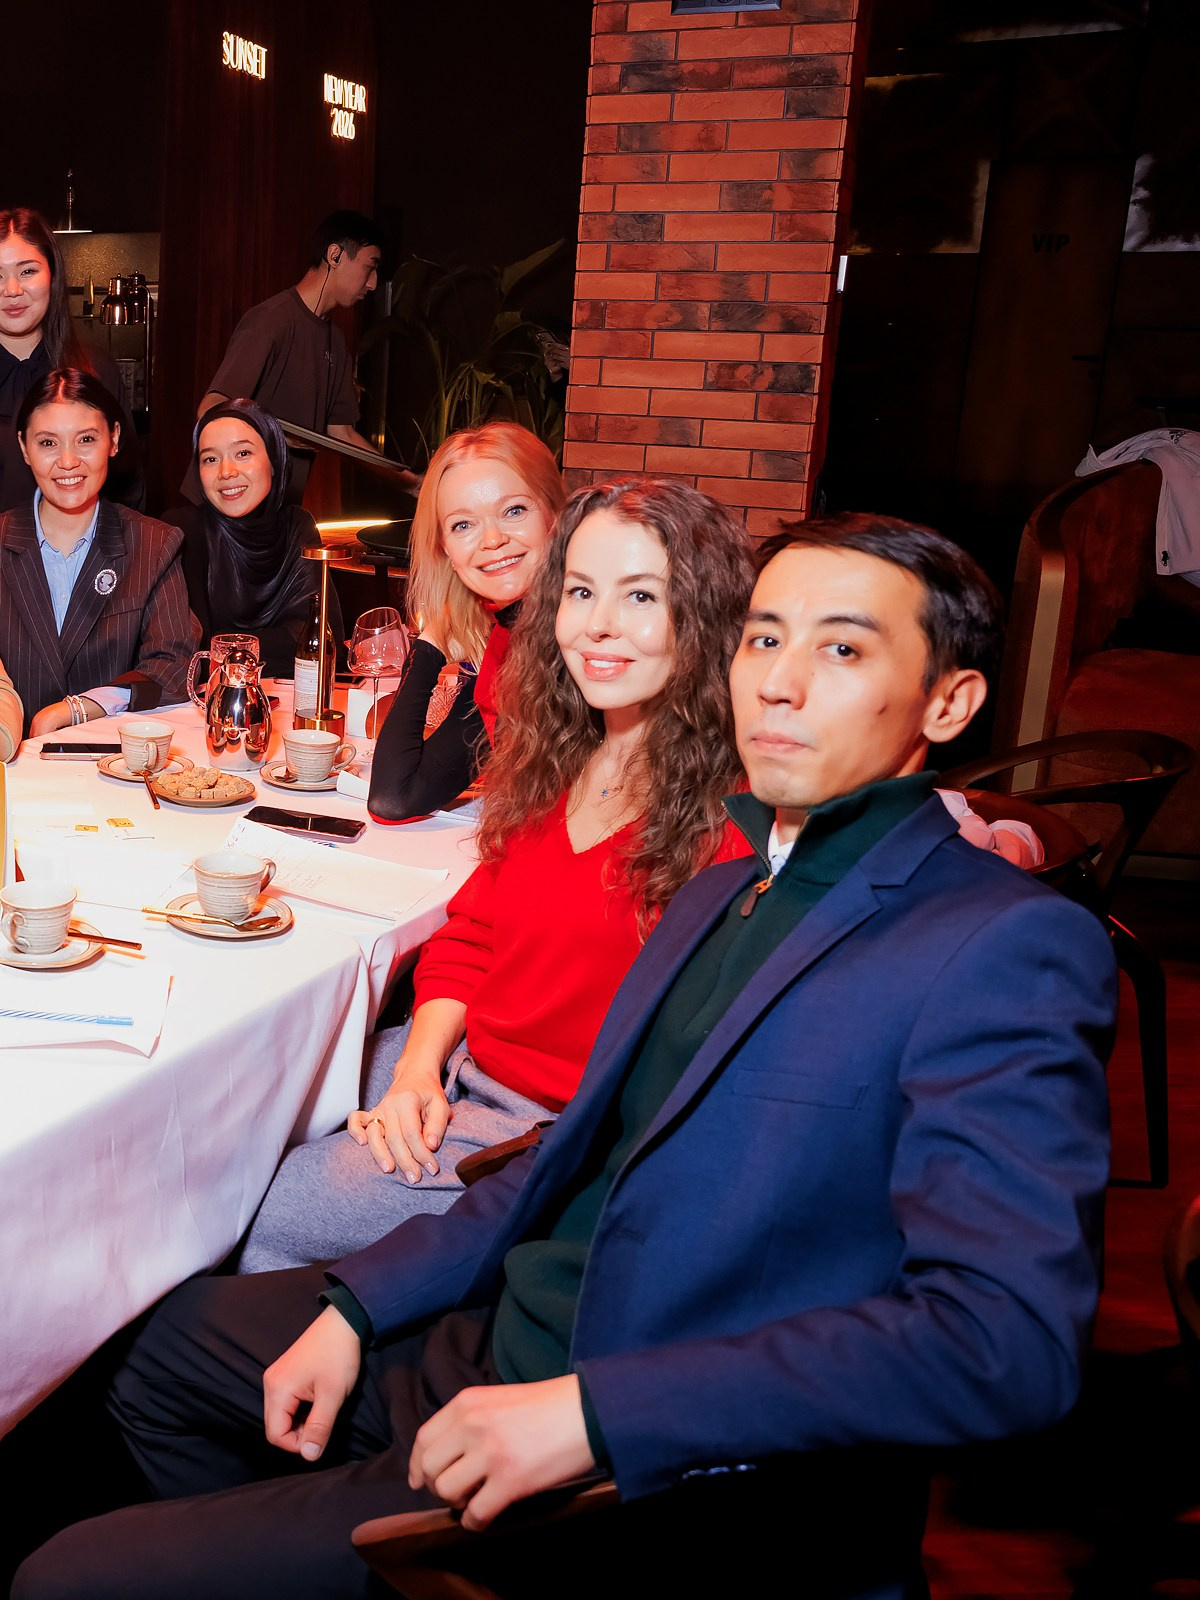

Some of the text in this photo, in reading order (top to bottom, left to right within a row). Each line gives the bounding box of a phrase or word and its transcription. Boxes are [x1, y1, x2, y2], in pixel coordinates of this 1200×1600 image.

[222, 31, 267, 79] SUNSET
[324, 73, 366, 112] NEW YEAR
[332, 108, 355, 139] 2026
[1032, 233, 1070, 253] VIP
